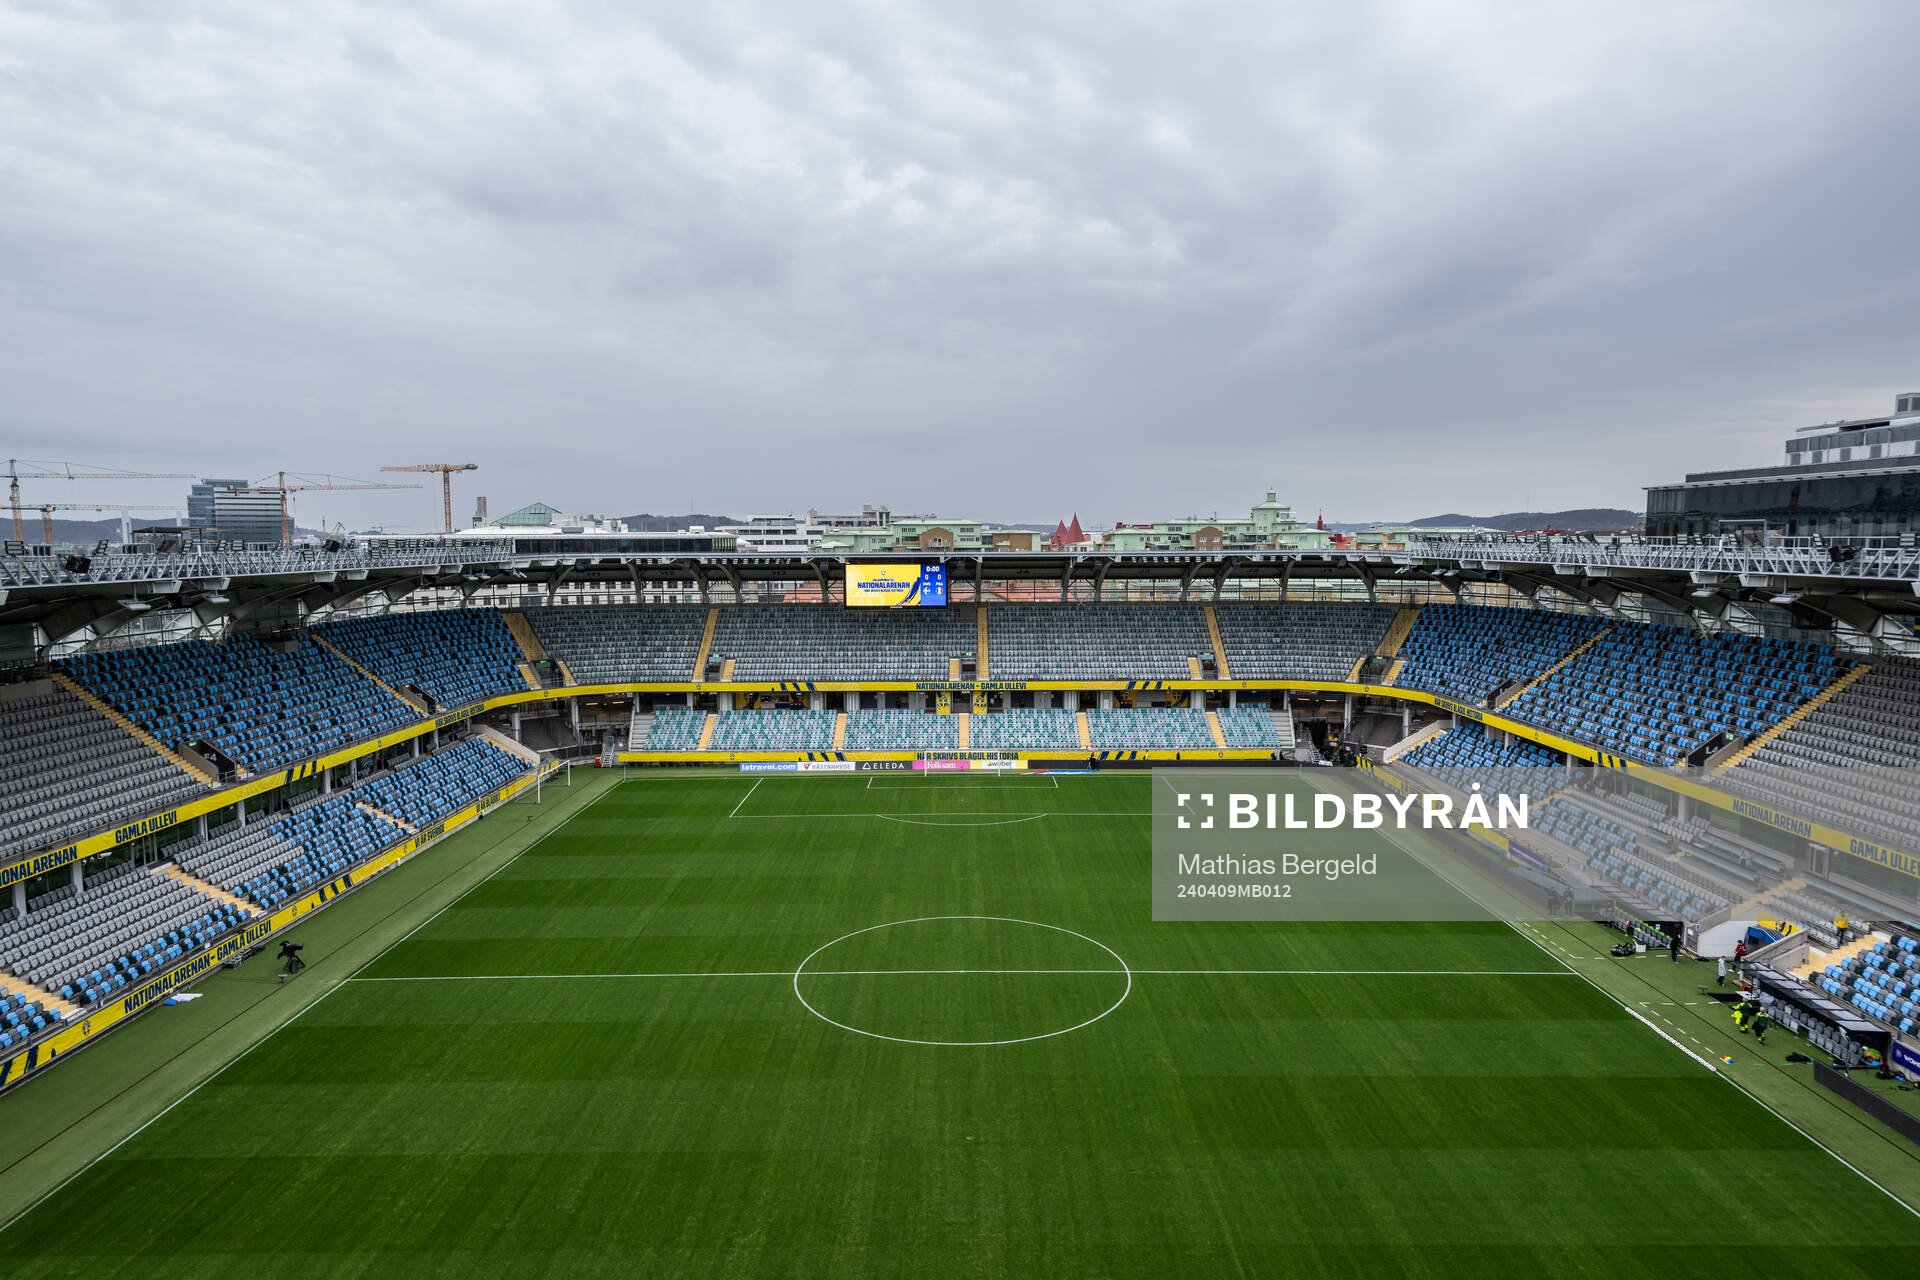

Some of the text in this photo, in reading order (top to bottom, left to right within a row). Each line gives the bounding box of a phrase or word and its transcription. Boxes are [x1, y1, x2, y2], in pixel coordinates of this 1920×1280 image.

[933, 752, 958, 760] SKRIVS
[987, 752, 1018, 760] HISTORIA
[115, 824, 148, 843] GAMLA
[149, 811, 177, 831] ULLEVI
[1732, 799, 1811, 837] NATIONALARENAN
[1850, 839, 1888, 865] GAMLA
[124, 956, 210, 1013] NATIONALARENAN
[217, 936, 245, 961] GAMLA
[246, 920, 271, 944] ULLEVI
